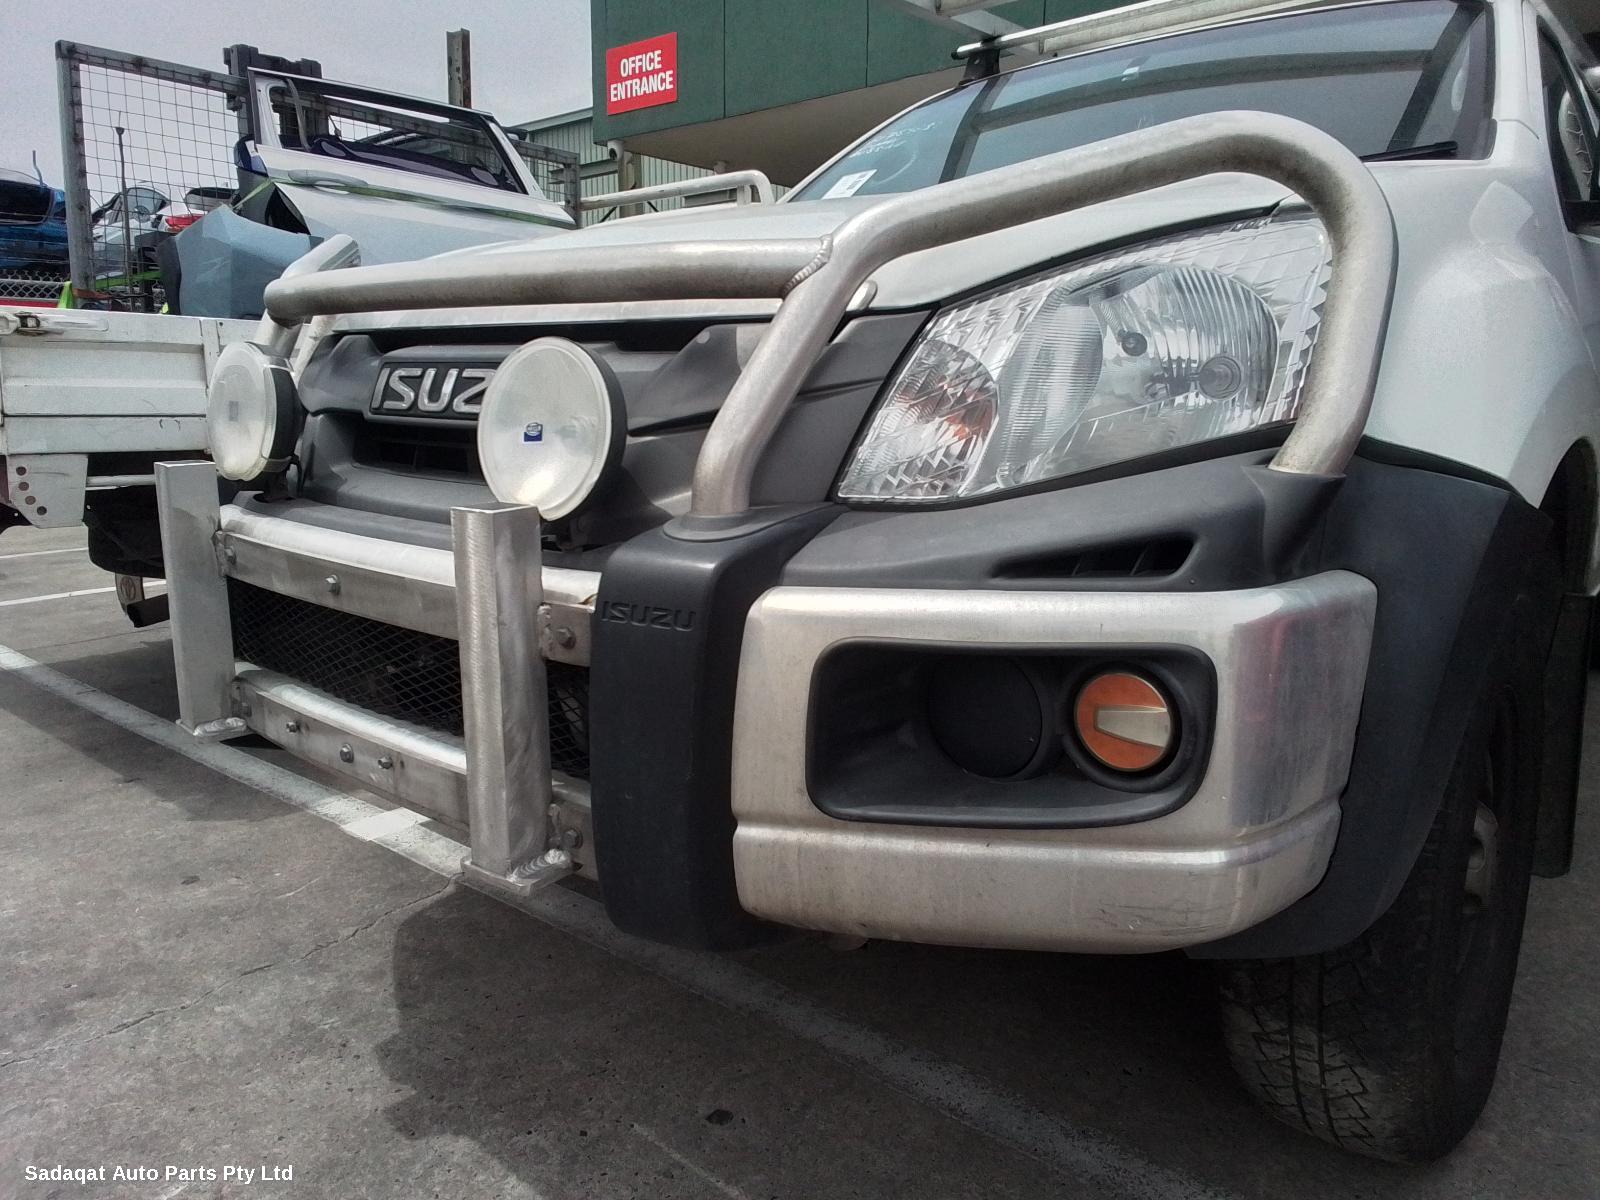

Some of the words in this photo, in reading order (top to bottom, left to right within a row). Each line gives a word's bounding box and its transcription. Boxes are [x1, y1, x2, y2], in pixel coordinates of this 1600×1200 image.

[620, 49, 662, 78] OFFICE
[610, 69, 674, 102] ENTRANCE
[371, 367, 498, 413] ISUZ
[600, 600, 696, 632] ISUZU
